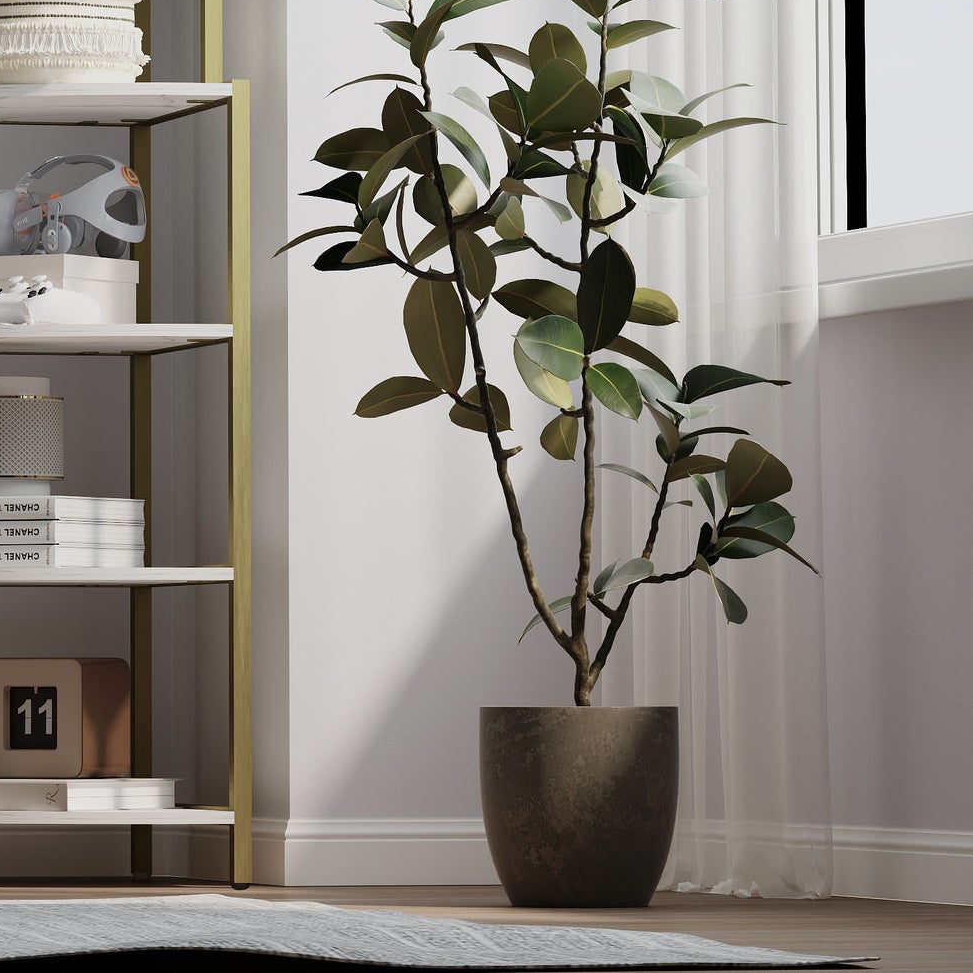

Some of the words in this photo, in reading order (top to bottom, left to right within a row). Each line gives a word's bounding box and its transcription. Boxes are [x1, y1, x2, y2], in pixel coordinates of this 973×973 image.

[4, 503, 40, 511] CHANEL
[4, 528, 40, 536] CHANEL
[4, 552, 40, 560] CHANEL
[17, 698, 53, 735] 11
